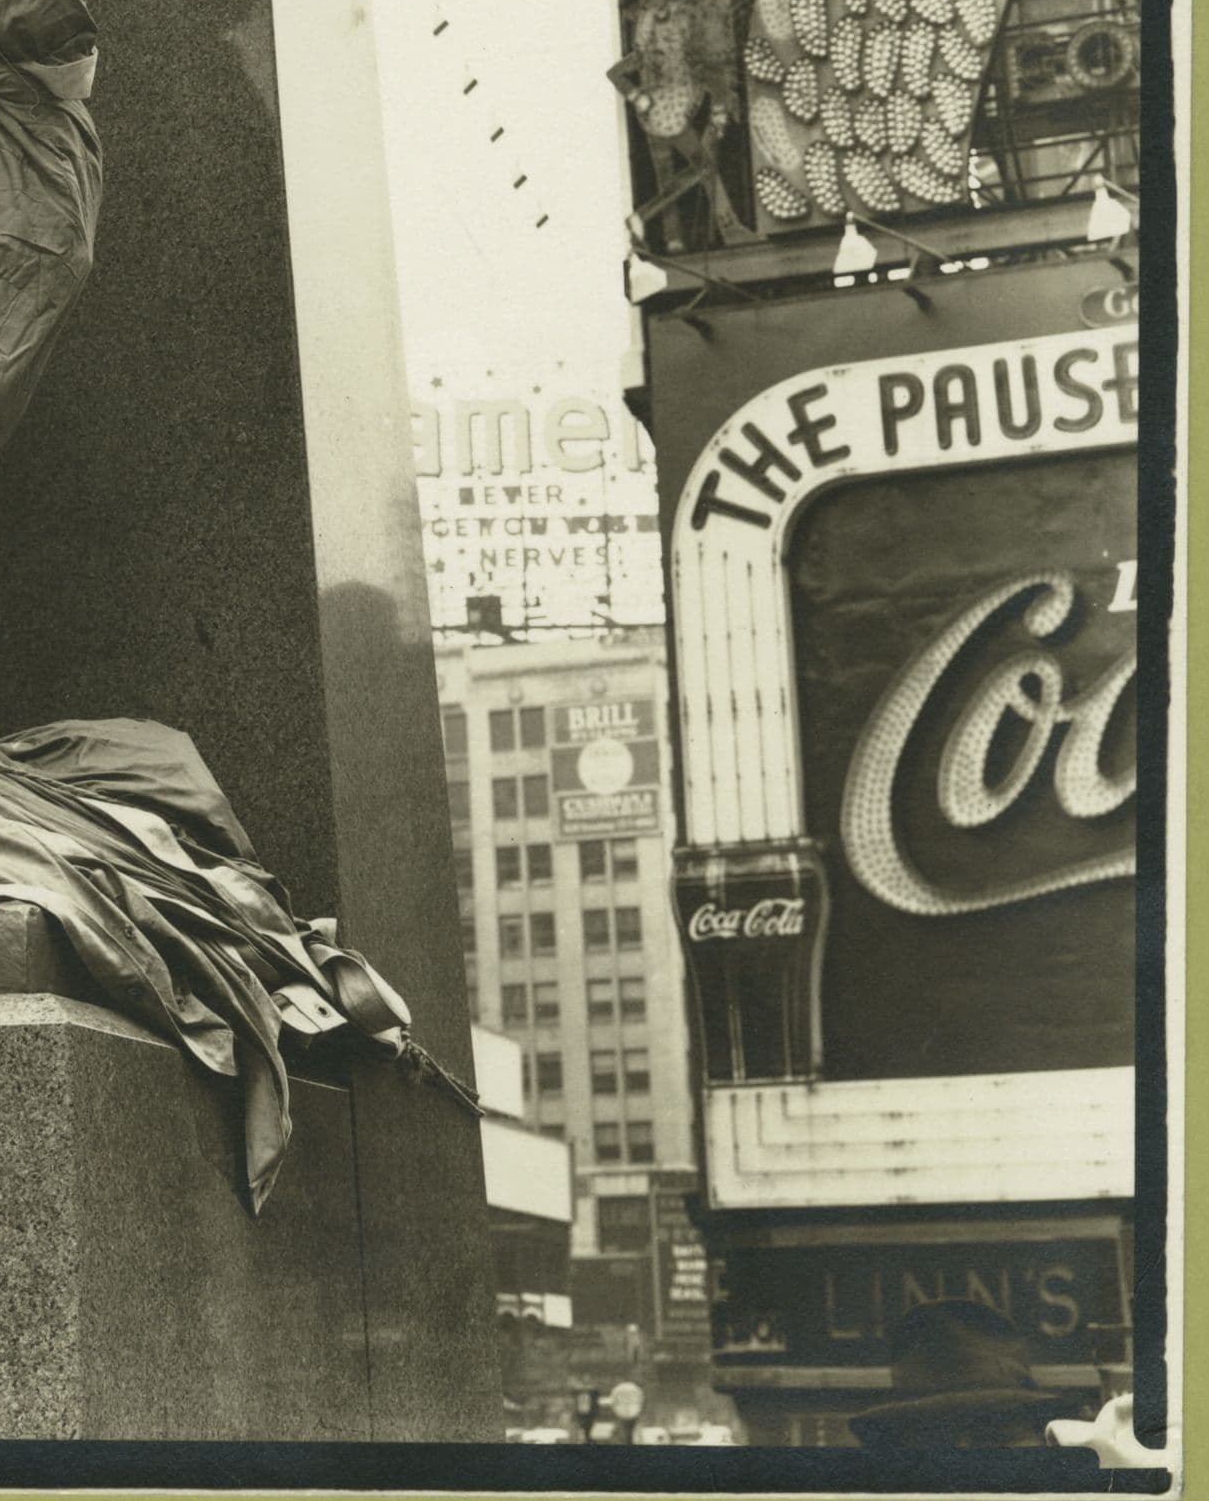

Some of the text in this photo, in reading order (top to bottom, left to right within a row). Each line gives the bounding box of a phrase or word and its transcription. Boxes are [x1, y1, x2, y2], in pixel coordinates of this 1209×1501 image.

[691, 339, 1139, 532] THE PAUSE
[568, 703, 639, 731] BRILL
